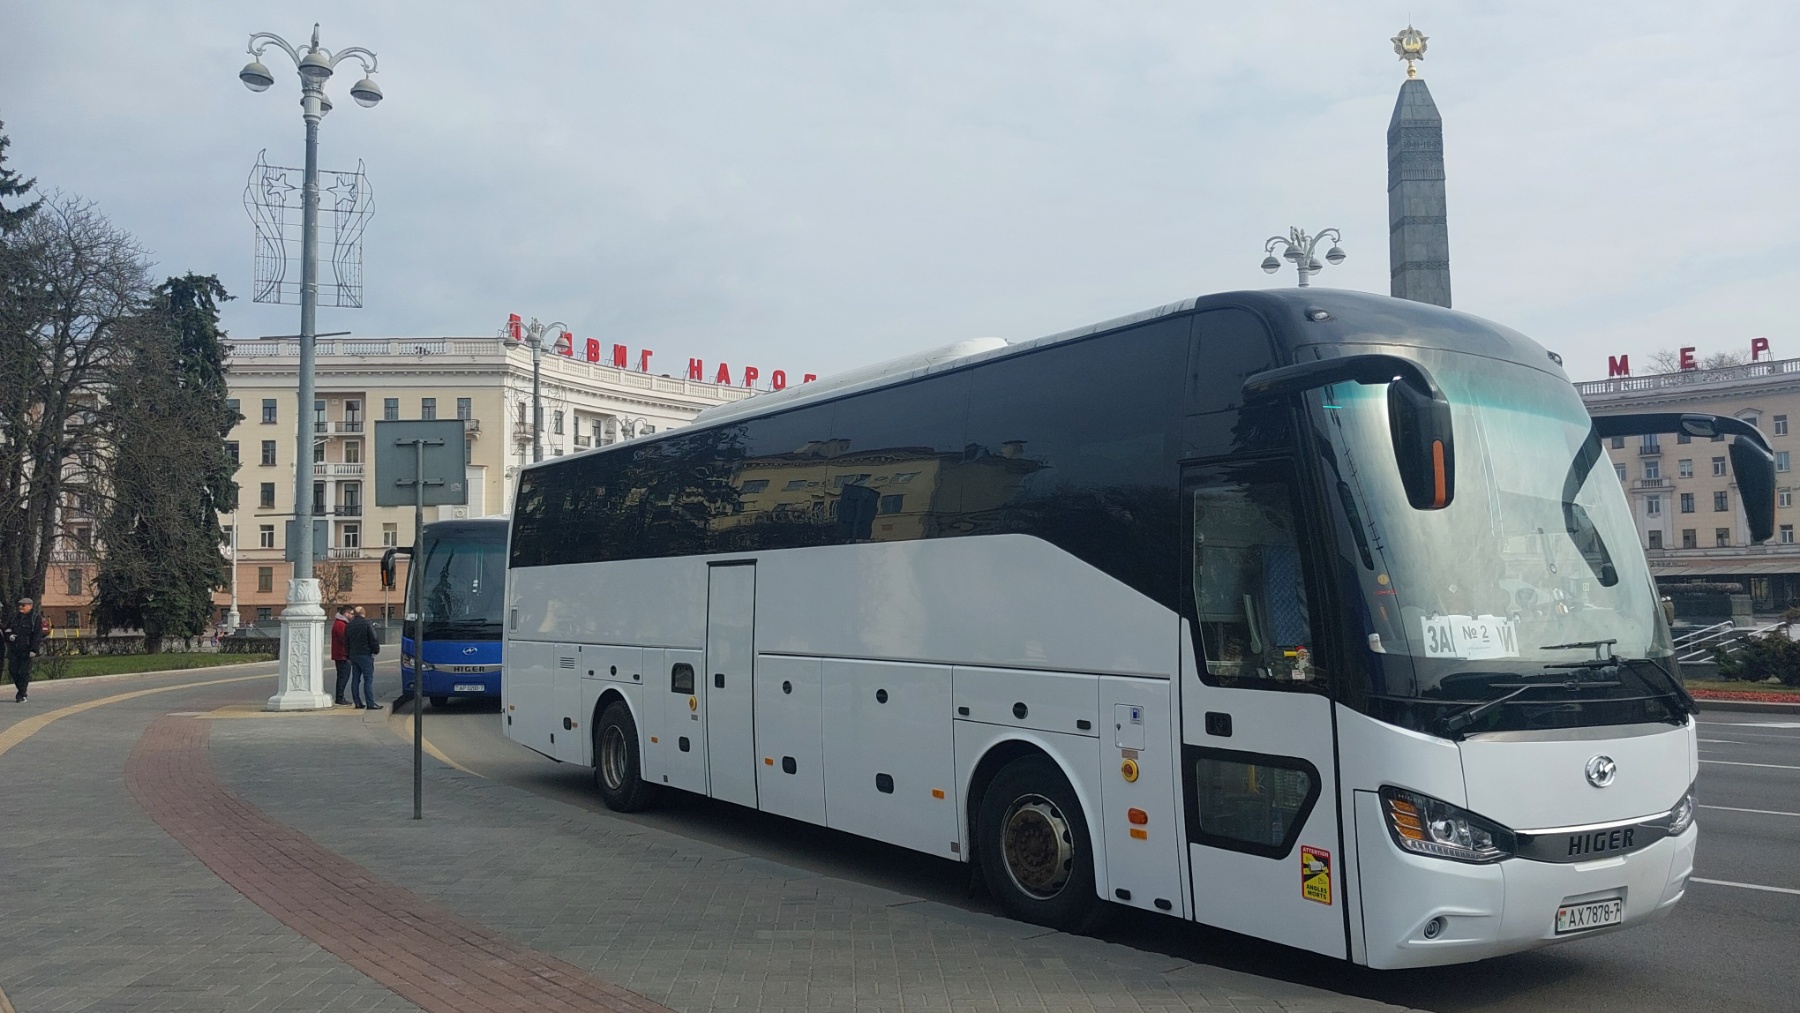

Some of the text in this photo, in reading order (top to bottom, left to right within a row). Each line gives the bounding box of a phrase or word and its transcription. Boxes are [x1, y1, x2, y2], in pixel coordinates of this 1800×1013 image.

[509, 313, 653, 372] ПДВИГ
[1480, 625, 1490, 642] 2
[1568, 828, 1635, 856] HIGER
[1303, 847, 1328, 857] ATTENTION
[1306, 884, 1327, 893] ANGLES
[1307, 890, 1327, 900] MORTS
